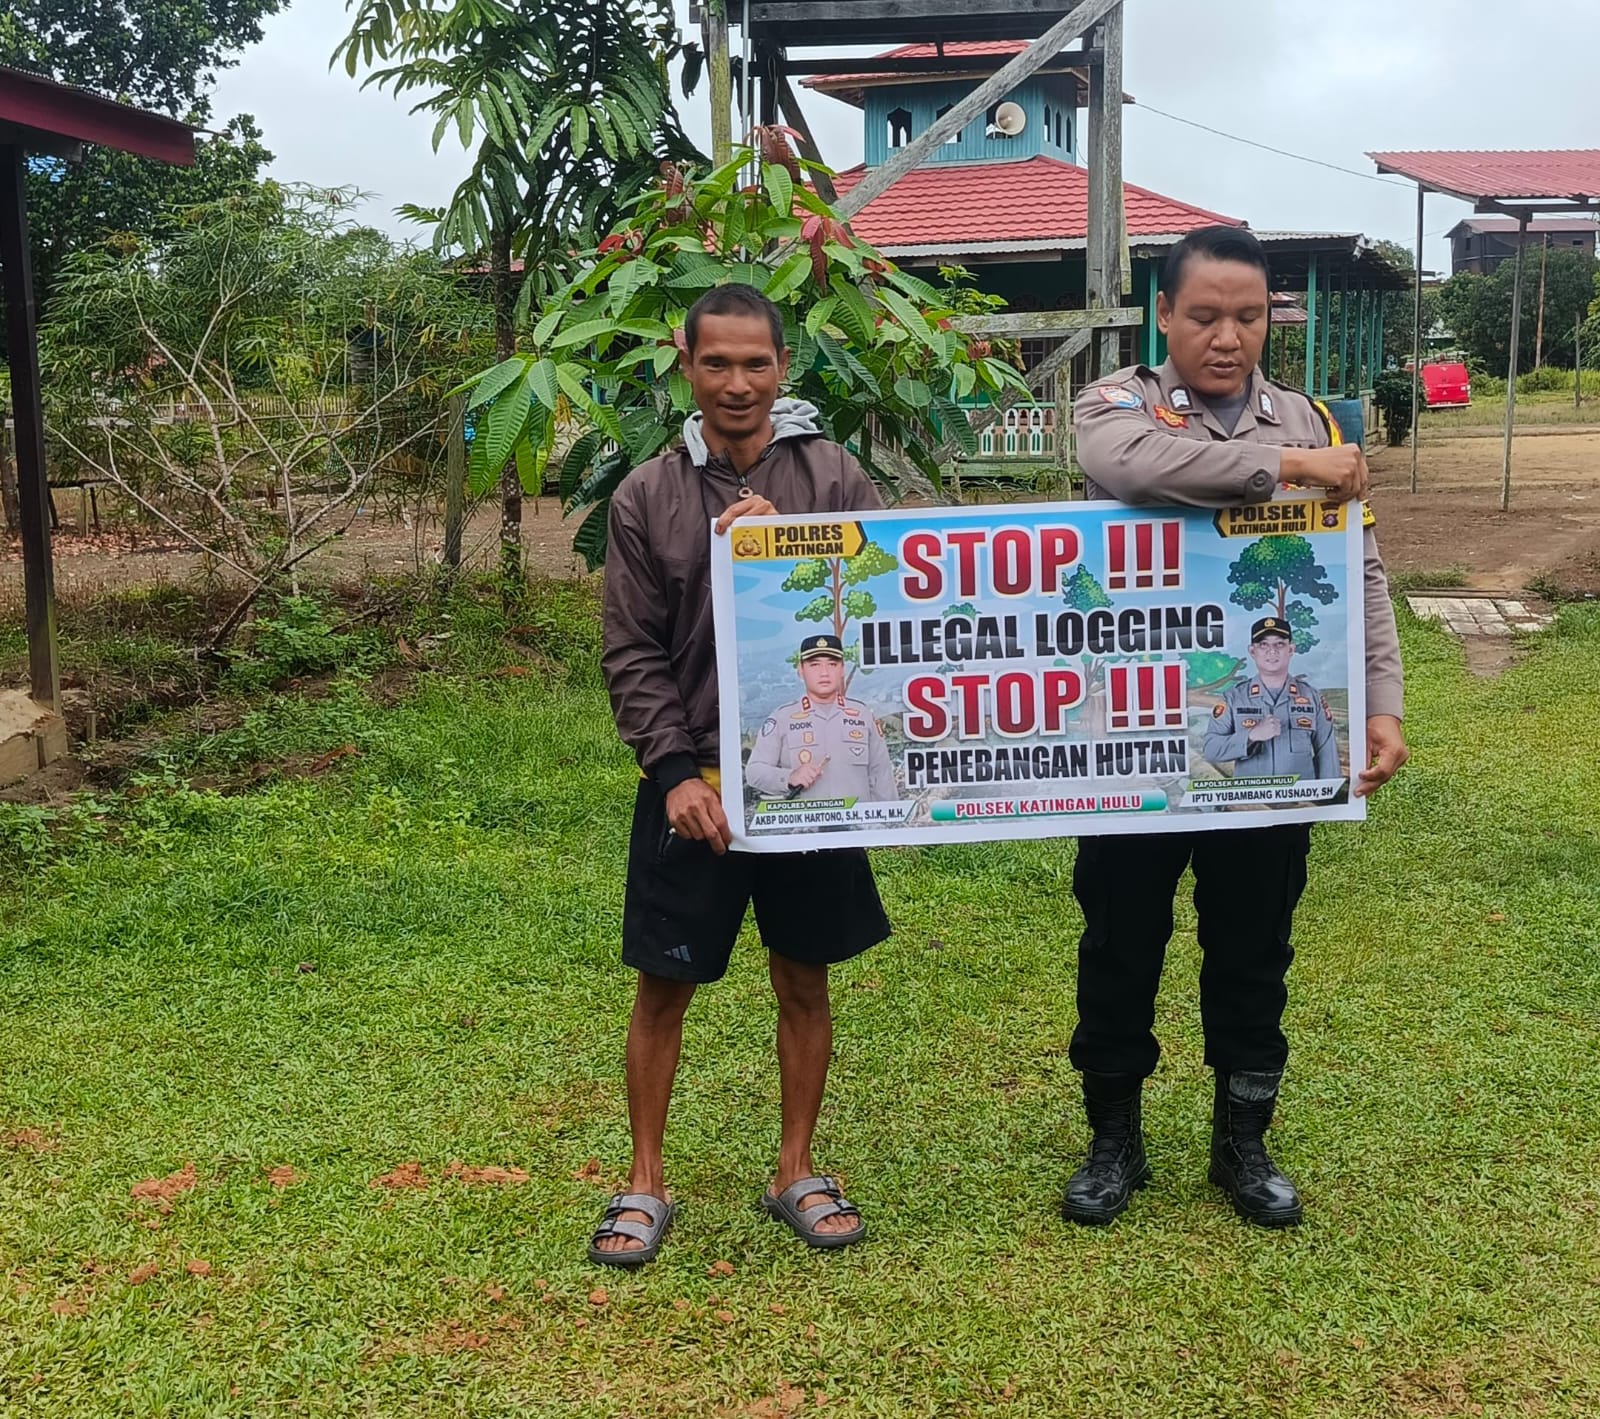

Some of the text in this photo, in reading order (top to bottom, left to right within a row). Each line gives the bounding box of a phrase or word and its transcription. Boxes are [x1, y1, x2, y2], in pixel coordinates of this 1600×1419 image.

[1229, 503, 1307, 522] POLSEK
[774, 525, 843, 543] POLRES
[1230, 521, 1307, 535] KATINGAN HULU
[775, 542, 844, 557] KATINGAN
[903, 521, 1181, 600] STOP !!!
[861, 604, 1224, 665] ILLEGAL LOGGING
[907, 664, 1182, 738] STOP !!!
[789, 720, 813, 730] DODIK
[907, 739, 1187, 785] PENEBANGAN HUTAN
[1193, 777, 1293, 788] KAPOLSEK KATINGAN HULU
[1192, 786, 1334, 803] IPTU YUBAMBANG KUSNADY, SH
[766, 799, 845, 811] KAPOLRES KATINGAN
[955, 795, 1141, 817] POLSEK KATINGAN HULU
[755, 814, 776, 825] AKBP
[778, 813, 802, 824] DODIK
[804, 811, 844, 824] HARTONO,
[888, 808, 905, 819] M.H.
